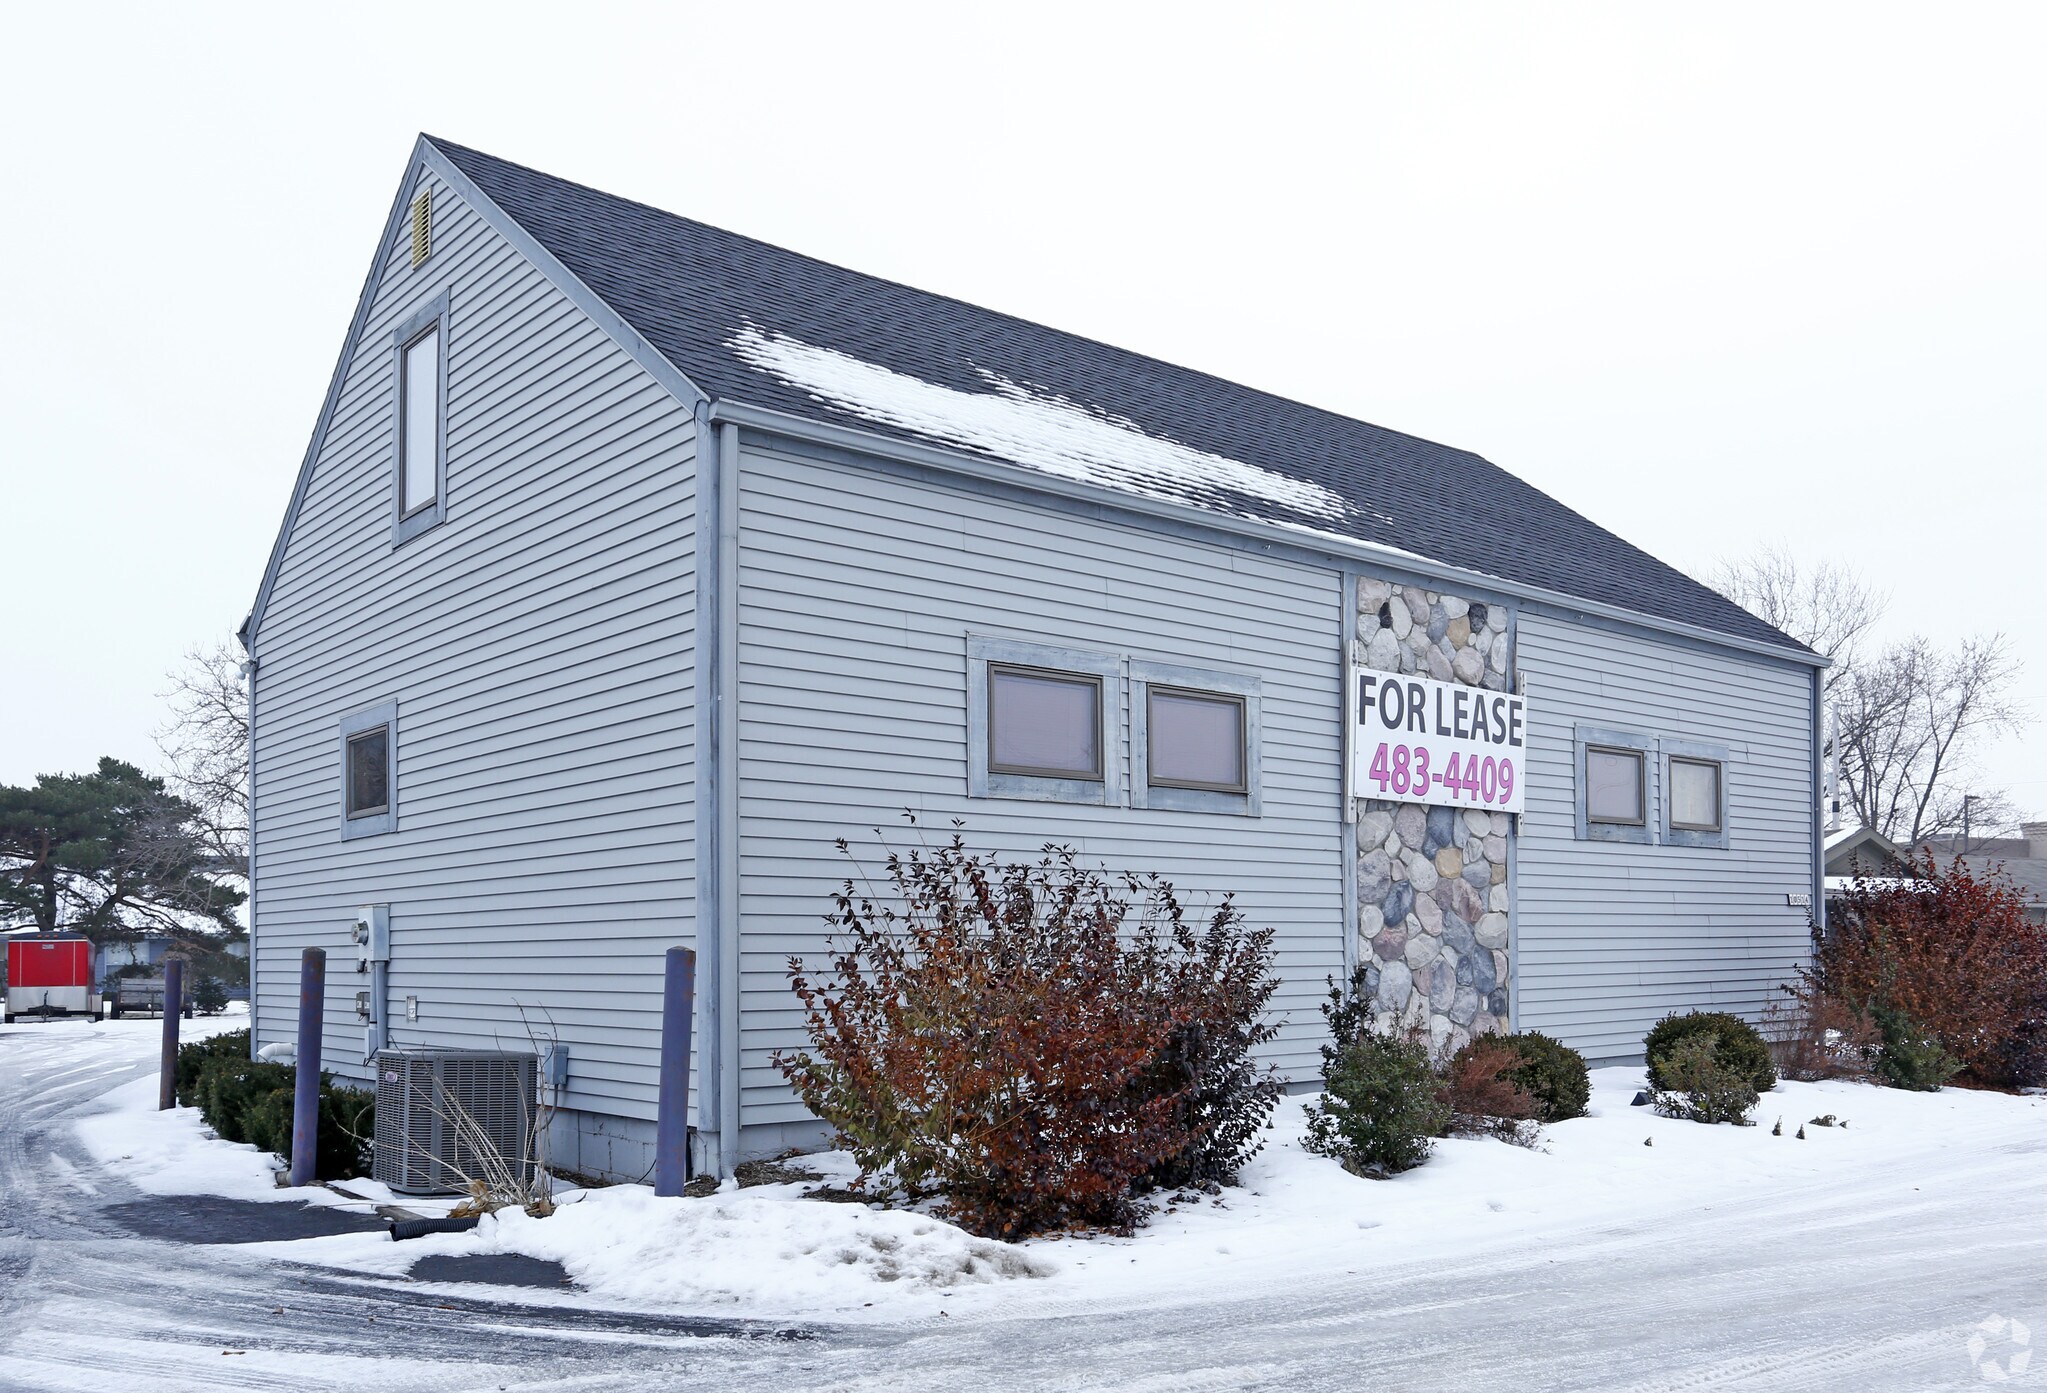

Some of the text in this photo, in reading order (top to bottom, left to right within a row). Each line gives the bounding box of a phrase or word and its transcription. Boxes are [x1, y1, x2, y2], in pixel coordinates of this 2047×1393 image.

[1358, 675, 1523, 747] FOR LEASE
[1369, 742, 1514, 804] 483-4409
